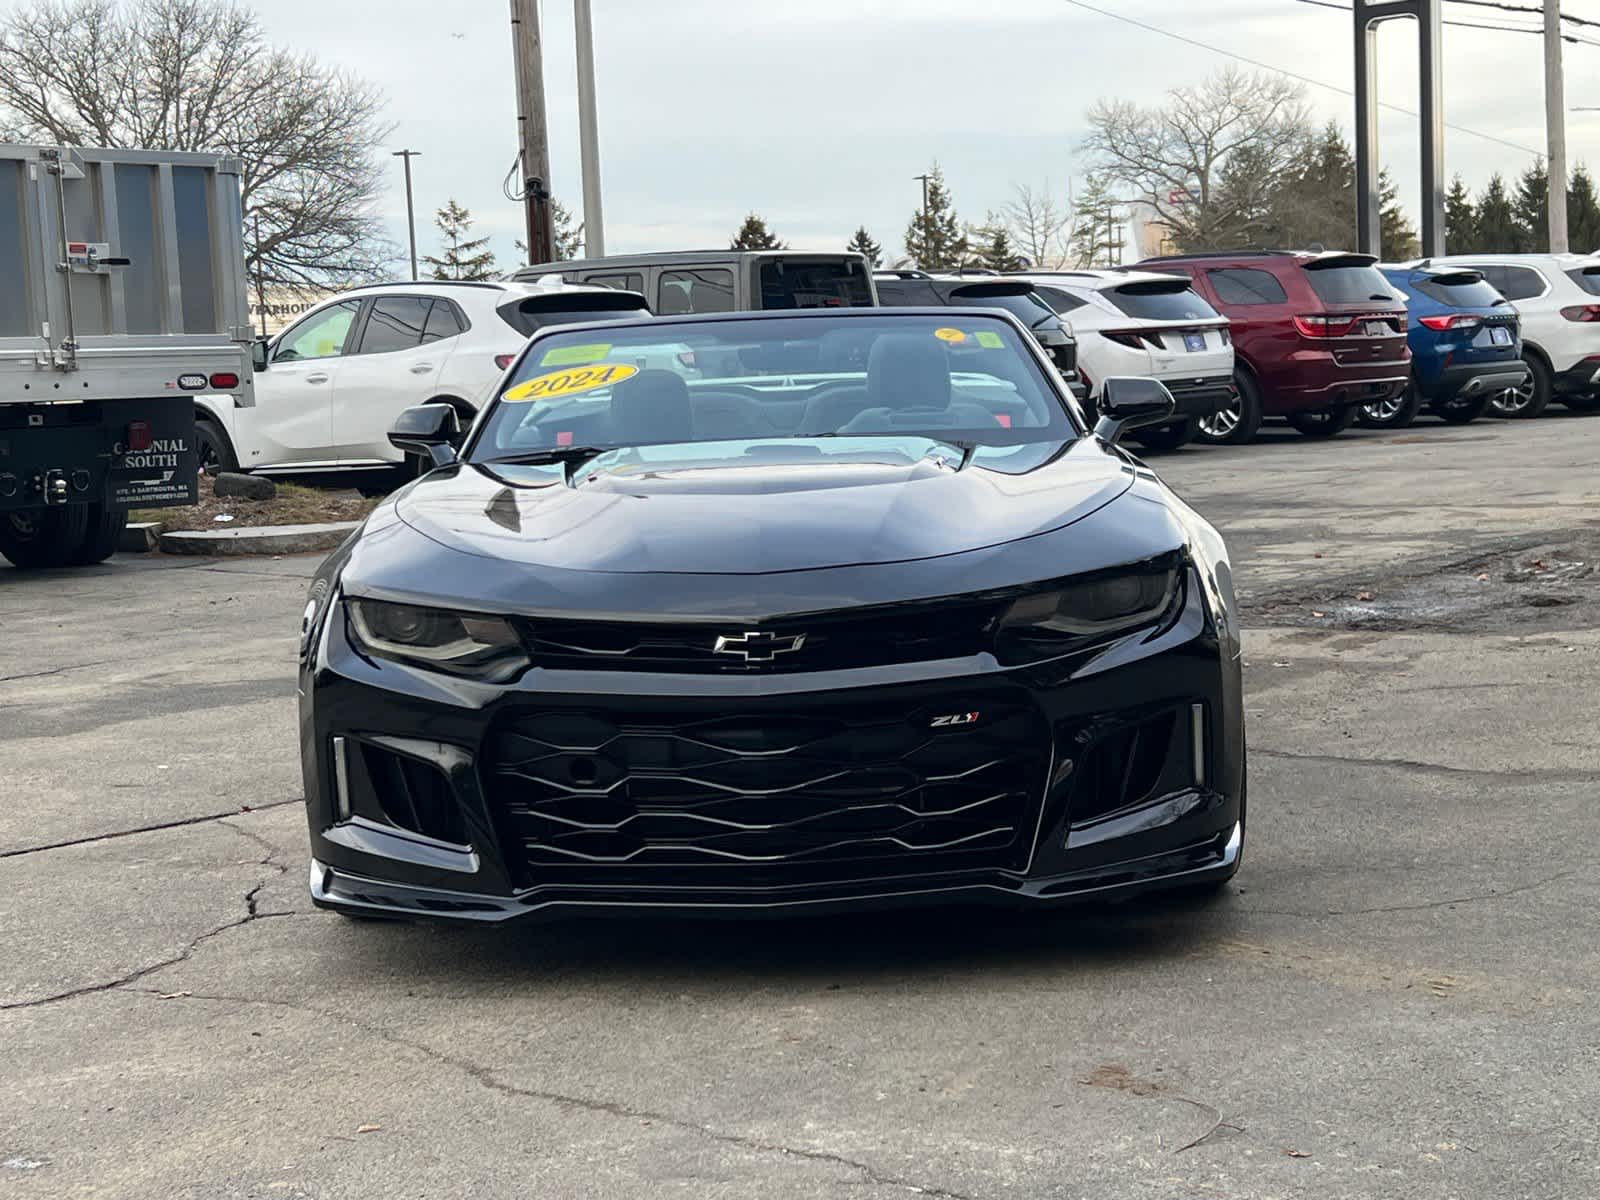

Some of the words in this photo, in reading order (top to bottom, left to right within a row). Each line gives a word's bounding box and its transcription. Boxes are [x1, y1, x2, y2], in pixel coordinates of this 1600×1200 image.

[524, 366, 617, 398] 2024
[125, 454, 177, 468] SOUTH
[930, 711, 979, 727] ZL1
